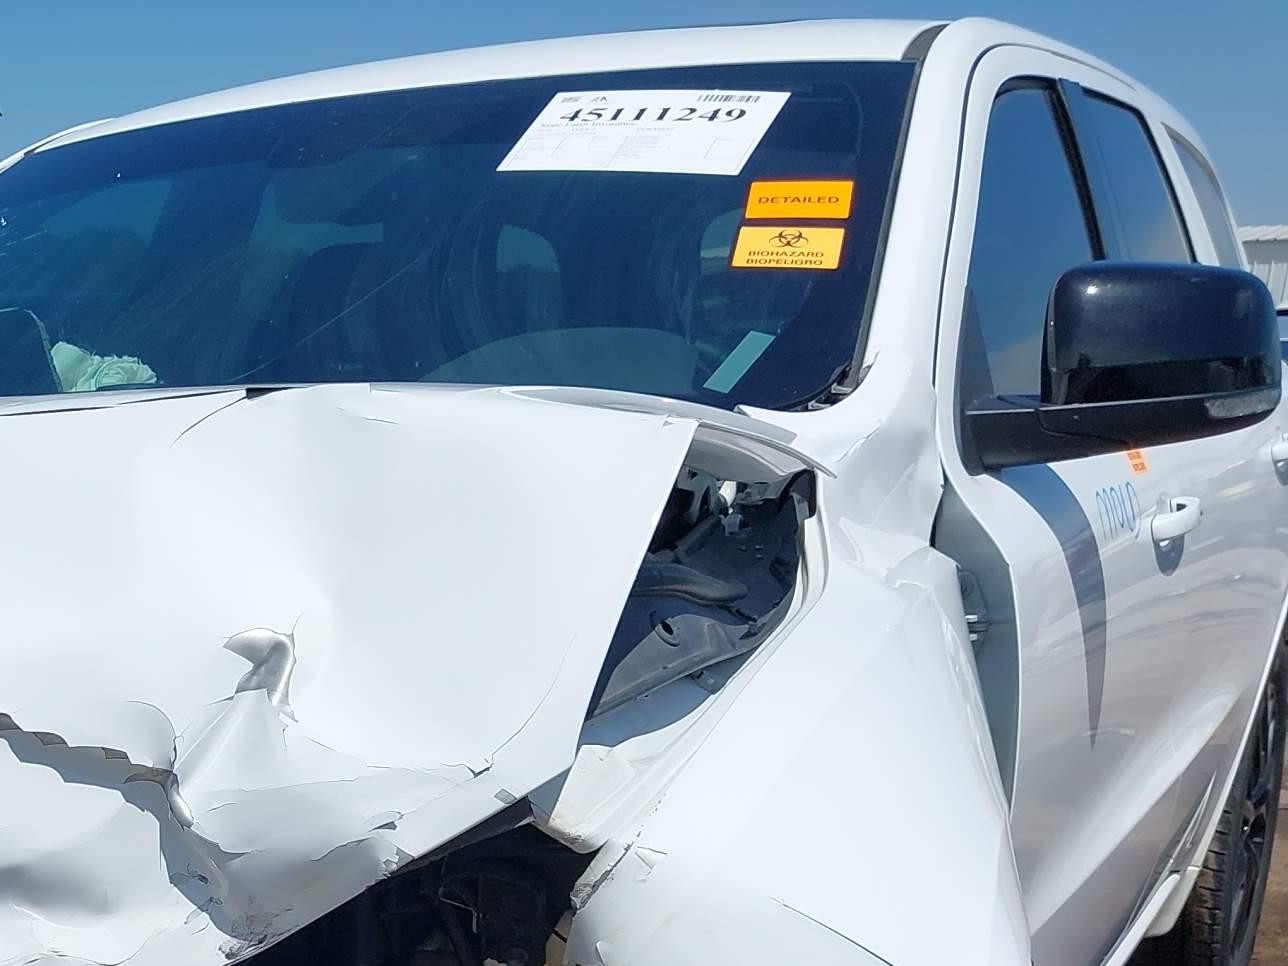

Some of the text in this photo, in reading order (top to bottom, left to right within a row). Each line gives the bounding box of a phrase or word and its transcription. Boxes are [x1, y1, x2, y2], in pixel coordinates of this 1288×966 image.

[559, 106, 747, 123] 45111249
[758, 196, 840, 204] DETAILED
[748, 250, 824, 258] BIOHAZARD
[745, 258, 823, 266] BIOPELIGRO
